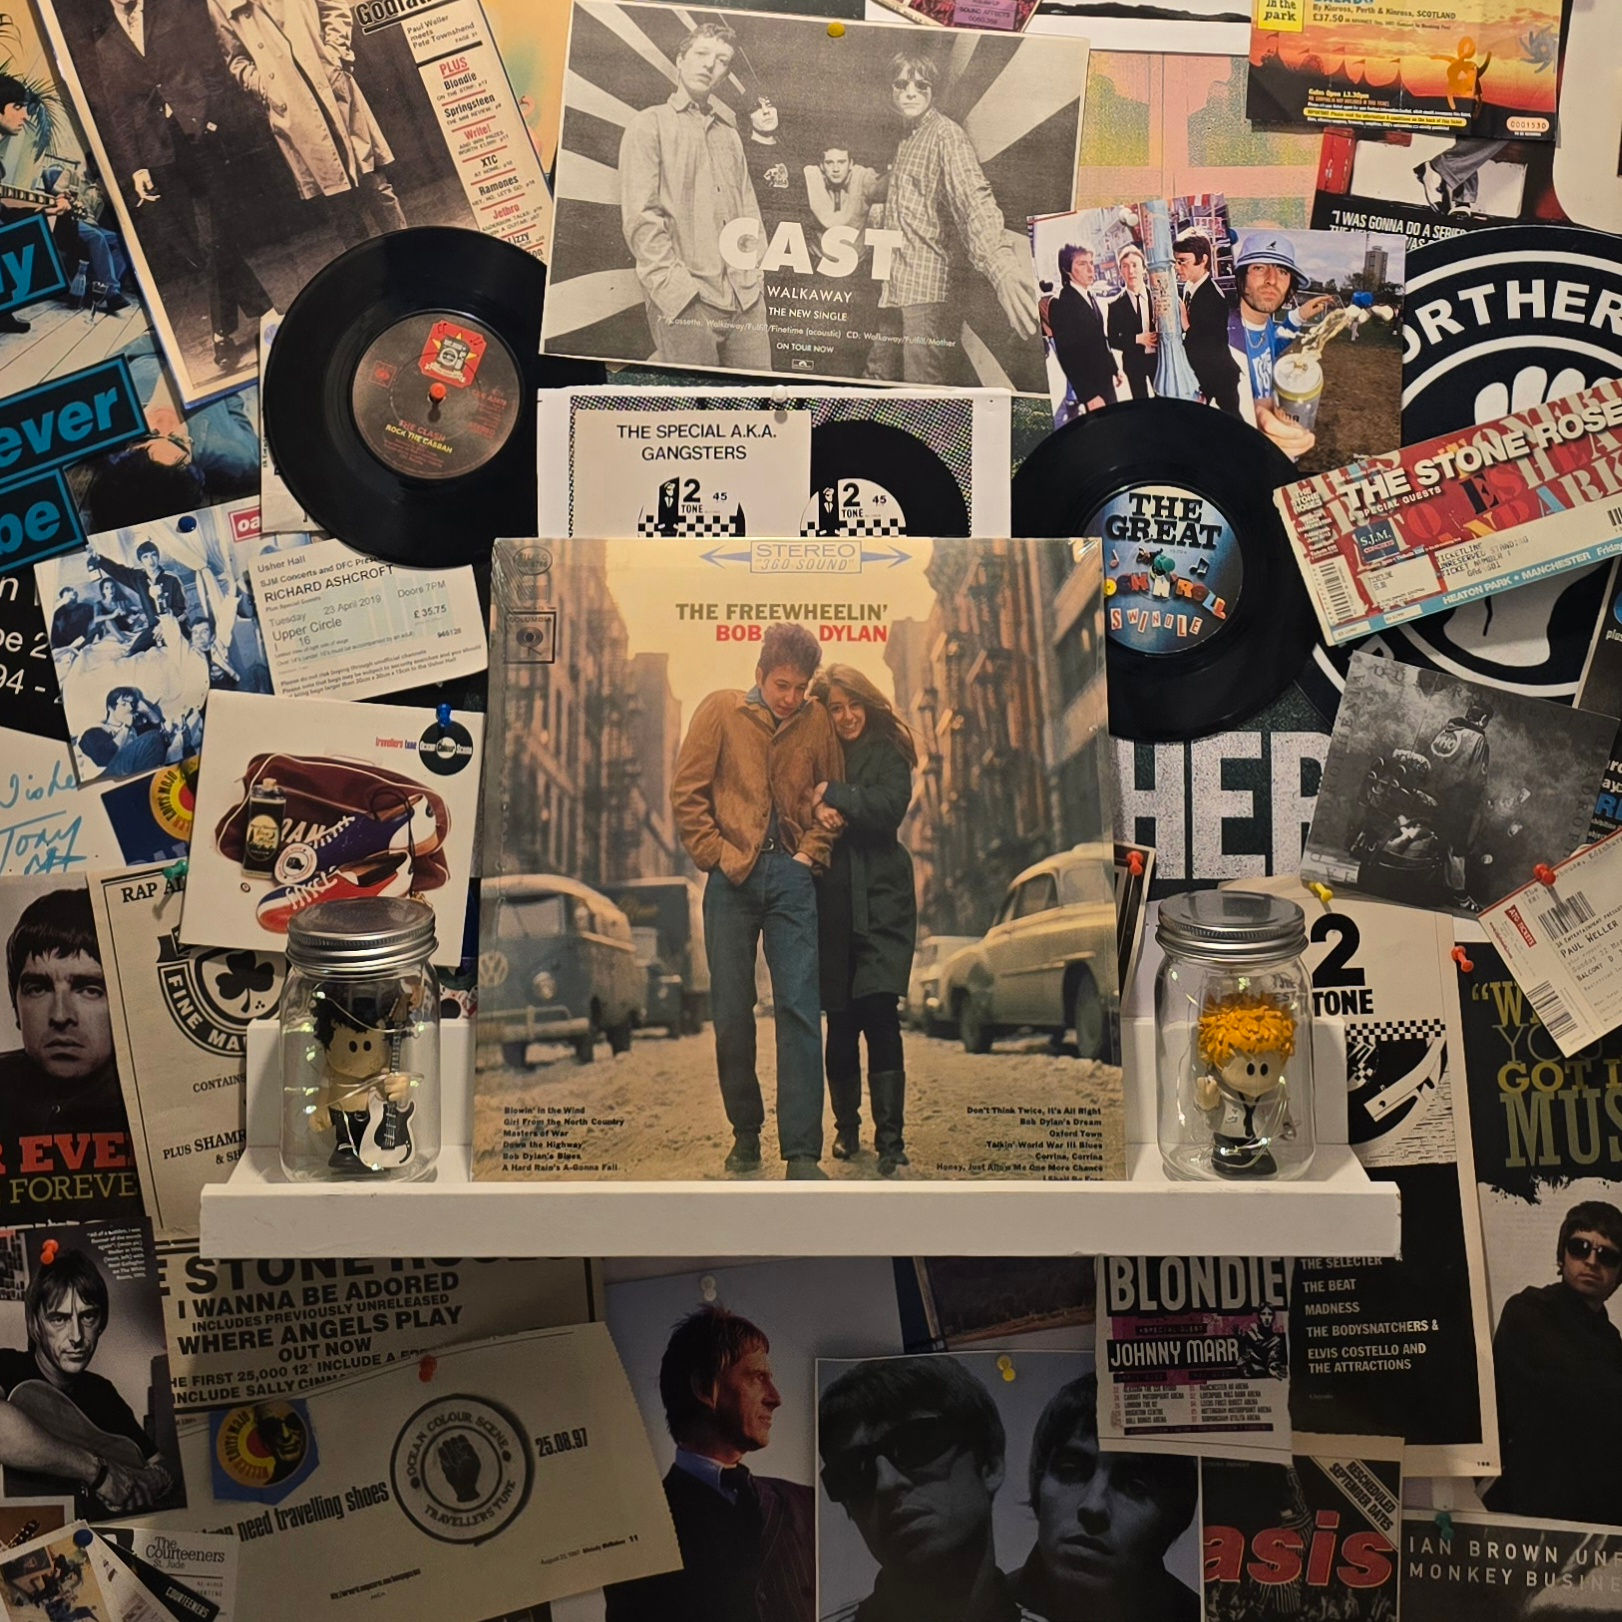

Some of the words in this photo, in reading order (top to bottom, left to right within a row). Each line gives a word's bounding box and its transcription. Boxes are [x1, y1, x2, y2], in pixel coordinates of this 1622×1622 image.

[1264, 10, 1297, 22] park
[1312, 4, 1323, 12] By
[1357, 5, 1375, 15] Perth
[1377, 7, 1385, 15] &
[1416, 9, 1457, 20] SCOTLAND
[1312, 13, 1344, 23] £37.50
[407, 23, 424, 34] Paul
[424, 14, 450, 28] Weller
[413, 39, 431, 50] Pete
[431, 22, 475, 42] Townshend
[439, 57, 468, 77] PLUS
[443, 72, 478, 91] Blondie
[444, 93, 496, 118] Springsteen
[463, 123, 492, 141] Write!
[480, 154, 499, 169] XTC
[478, 175, 520, 196] Ramones
[492, 202, 521, 220] Jethro
[1341, 211, 1367, 228] WAS
[1368, 215, 1404, 234] GONNA
[1406, 221, 1421, 236] DO
[1422, 223, 1432, 238] A
[719, 216, 904, 281] CAST
[767, 285, 853, 304] WALKAWAY
[768, 307, 787, 316] THE
[788, 308, 812, 319] NEW
[813, 311, 848, 322] SINGLE
[776, 342, 790, 350] ON
[791, 343, 812, 352] TOUR
[813, 345, 836, 354] NOW
[385, 423, 407, 437] ROCK
[407, 431, 424, 443] THE
[616, 424, 652, 439] THE
[655, 423, 727, 439] SPECIAL
[730, 423, 778, 439] A.K.A.
[641, 445, 748, 461] GANGSTERS
[1336, 467, 1412, 511] THE
[1413, 430, 1531, 487] STONE
[682, 478, 702, 503] 2
[711, 491, 729, 501] 45
[841, 482, 862, 508] 2
[871, 494, 888, 504] 45
[1401, 485, 1442, 506] GUESTS
[680, 503, 704, 514] TONE
[840, 507, 864, 518] TONE
[1128, 492, 1204, 524] THE
[1105, 514, 1223, 550] GREAT
[1359, 529, 1393, 546] S.J.M.
[756, 543, 856, 558] STEREO
[257, 560, 286, 574] Usher
[287, 555, 306, 567] Hall
[260, 576, 278, 588] SJM
[279, 568, 317, 584] Concerts
[319, 564, 335, 575] and
[336, 560, 354, 571] DFC
[264, 580, 323, 603] RICHARD
[324, 563, 394, 590] ASHCROFT
[1441, 584, 1485, 605] HEATON
[1484, 576, 1513, 593] PARK
[1521, 551, 1592, 581] MANCHESTER
[322, 605, 336, 617] 23
[336, 598, 359, 616] April
[359, 594, 383, 608] 2019
[397, 586, 424, 599] Doors
[425, 580, 446, 592] 7PM
[421, 604, 448, 618] 35.75
[675, 603, 719, 621] THE
[725, 603, 889, 621] FREEWHEELIN'
[271, 624, 308, 643] Upper
[308, 616, 343, 634] Circle
[1109, 607, 1204, 638] SWINDLE
[716, 624, 763, 642] BOB
[818, 624, 888, 643] DYLAN
[121, 881, 158, 903] RAP
[1560, 942, 1584, 958] PAUL
[1584, 919, 1619, 943] WELLER
[1310, 913, 1366, 989] 2
[167, 974, 204, 1030] FINE
[1312, 988, 1375, 1017] TONE
[1497, 1060, 1593, 1093] GOT
[503, 1118, 520, 1126] Girl
[522, 1118, 545, 1126] From
[546, 1118, 562, 1127] the
[563, 1118, 589, 1126] North
[591, 1118, 625, 1127] Country
[163, 1144, 192, 1160] PLUS
[1301, 1257, 1324, 1271] THE
[1325, 1256, 1384, 1269] SELECTER
[1107, 1256, 1286, 1312] BLONDIE
[1302, 1280, 1326, 1293] THE
[1328, 1278, 1357, 1292] BEAT
[177, 1300, 186, 1319] I
[192, 1290, 296, 1319] WANNA
[302, 1284, 339, 1307] BE
[344, 1271, 460, 1300] ADORED
[192, 1316, 263, 1333] INCLUDES
[265, 1305, 354, 1325] PREVIOUSLY
[356, 1293, 450, 1312] UNRELEASED
[1305, 1301, 1361, 1316] MADNESS
[177, 1327, 275, 1355] WHERE
[280, 1312, 389, 1345] ANGELS
[394, 1305, 464, 1331] PLAY
[1306, 1325, 1330, 1338] THE
[1332, 1319, 1429, 1337] BODYSNATCHERS
[1431, 1319, 1440, 1331] &
[279, 1344, 321, 1363] OUT
[325, 1336, 373, 1358] NOW
[1110, 1340, 1182, 1367] JOHNNY
[1186, 1338, 1240, 1364] MARR
[1307, 1347, 1339, 1360] ELVIS
[1341, 1344, 1400, 1359] COSTELLO
[1402, 1342, 1427, 1355] AND
[192, 1371, 234, 1387] FIRST
[237, 1366, 289, 1384] 25,000
[317, 1353, 382, 1372] INCLUDE
[1308, 1361, 1332, 1374] THE
[1333, 1358, 1412, 1373] ATTRACTIONS
[246, 1380, 295, 1397] SALLY
[406, 1432, 428, 1476] OCEAN
[426, 1411, 473, 1433] COLOUR
[474, 1416, 510, 1449] SCENE
[534, 1427, 589, 1457] 25.08.97
[1328, 1462, 1369, 1509] SEPTEMBER
[1366, 1503, 1395, 1532] DATES
[1345, 1458, 1397, 1515] RESCHEDULED
[236, 1510, 274, 1542] need
[273, 1494, 345, 1531] travelling
[344, 1481, 390, 1512] shoes
[424, 1503, 496, 1528] TRAVELLERS
[491, 1478, 517, 1511] TUNE
[154, 1536, 178, 1550] The
[1409, 1535, 1452, 1555] IAN
[1469, 1540, 1558, 1564] BROWN
[145, 1544, 226, 1564] Courteeners
[1409, 1562, 1514, 1585] MONKEY
